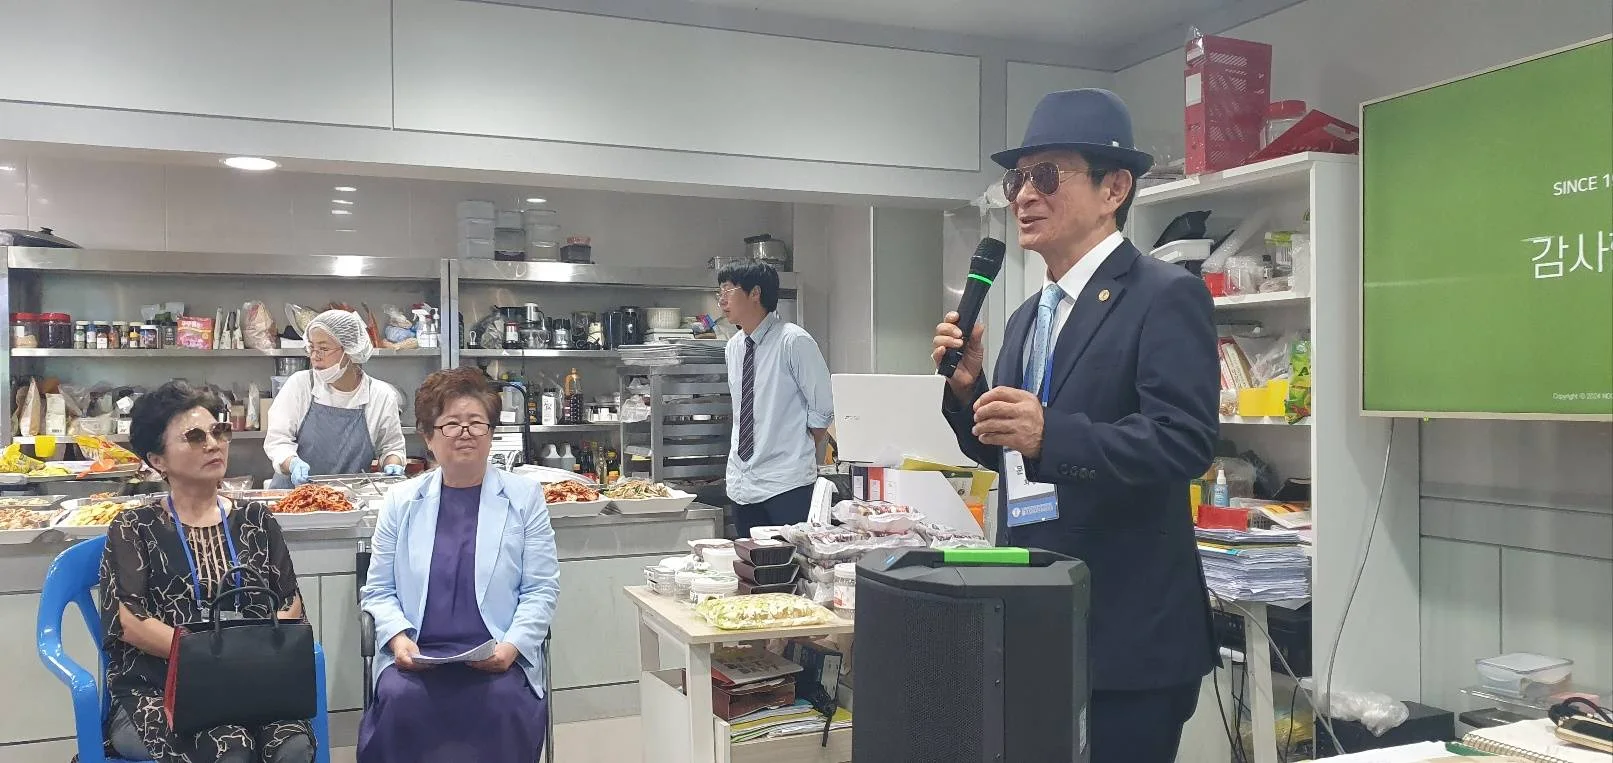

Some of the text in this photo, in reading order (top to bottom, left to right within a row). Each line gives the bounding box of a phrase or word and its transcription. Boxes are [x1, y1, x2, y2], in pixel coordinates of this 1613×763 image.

[1553, 174, 1613, 196] SINCE 1
[1531, 230, 1613, 279] 감사
[1552, 392, 1578, 401] Copyright
